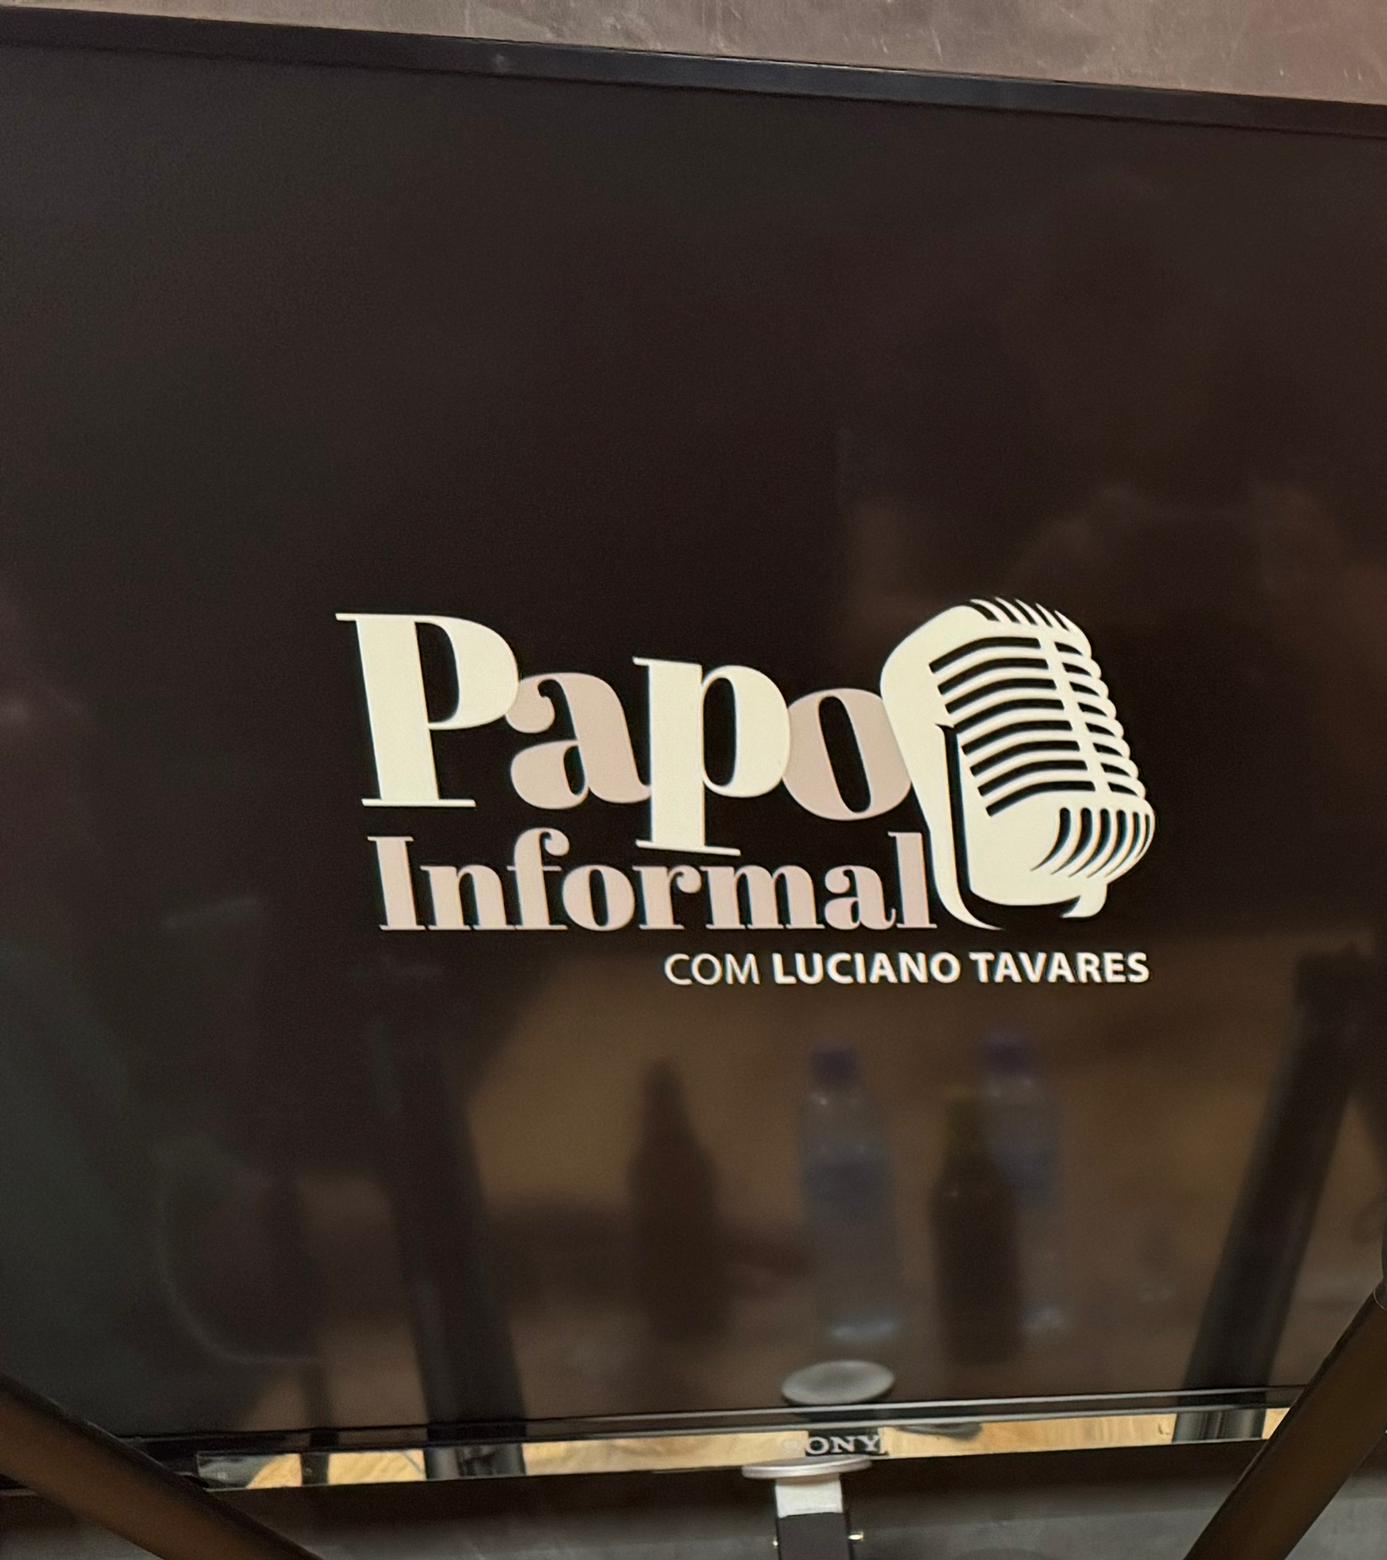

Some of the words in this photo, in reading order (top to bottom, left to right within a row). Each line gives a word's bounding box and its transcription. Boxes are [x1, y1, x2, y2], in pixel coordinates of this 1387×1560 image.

[336, 612, 913, 856] Papo
[367, 828, 938, 931] Informal
[664, 952, 760, 986] COM
[772, 951, 961, 985] LUCIANO
[969, 951, 1150, 985] TAVARES
[783, 1435, 880, 1455] ONY
